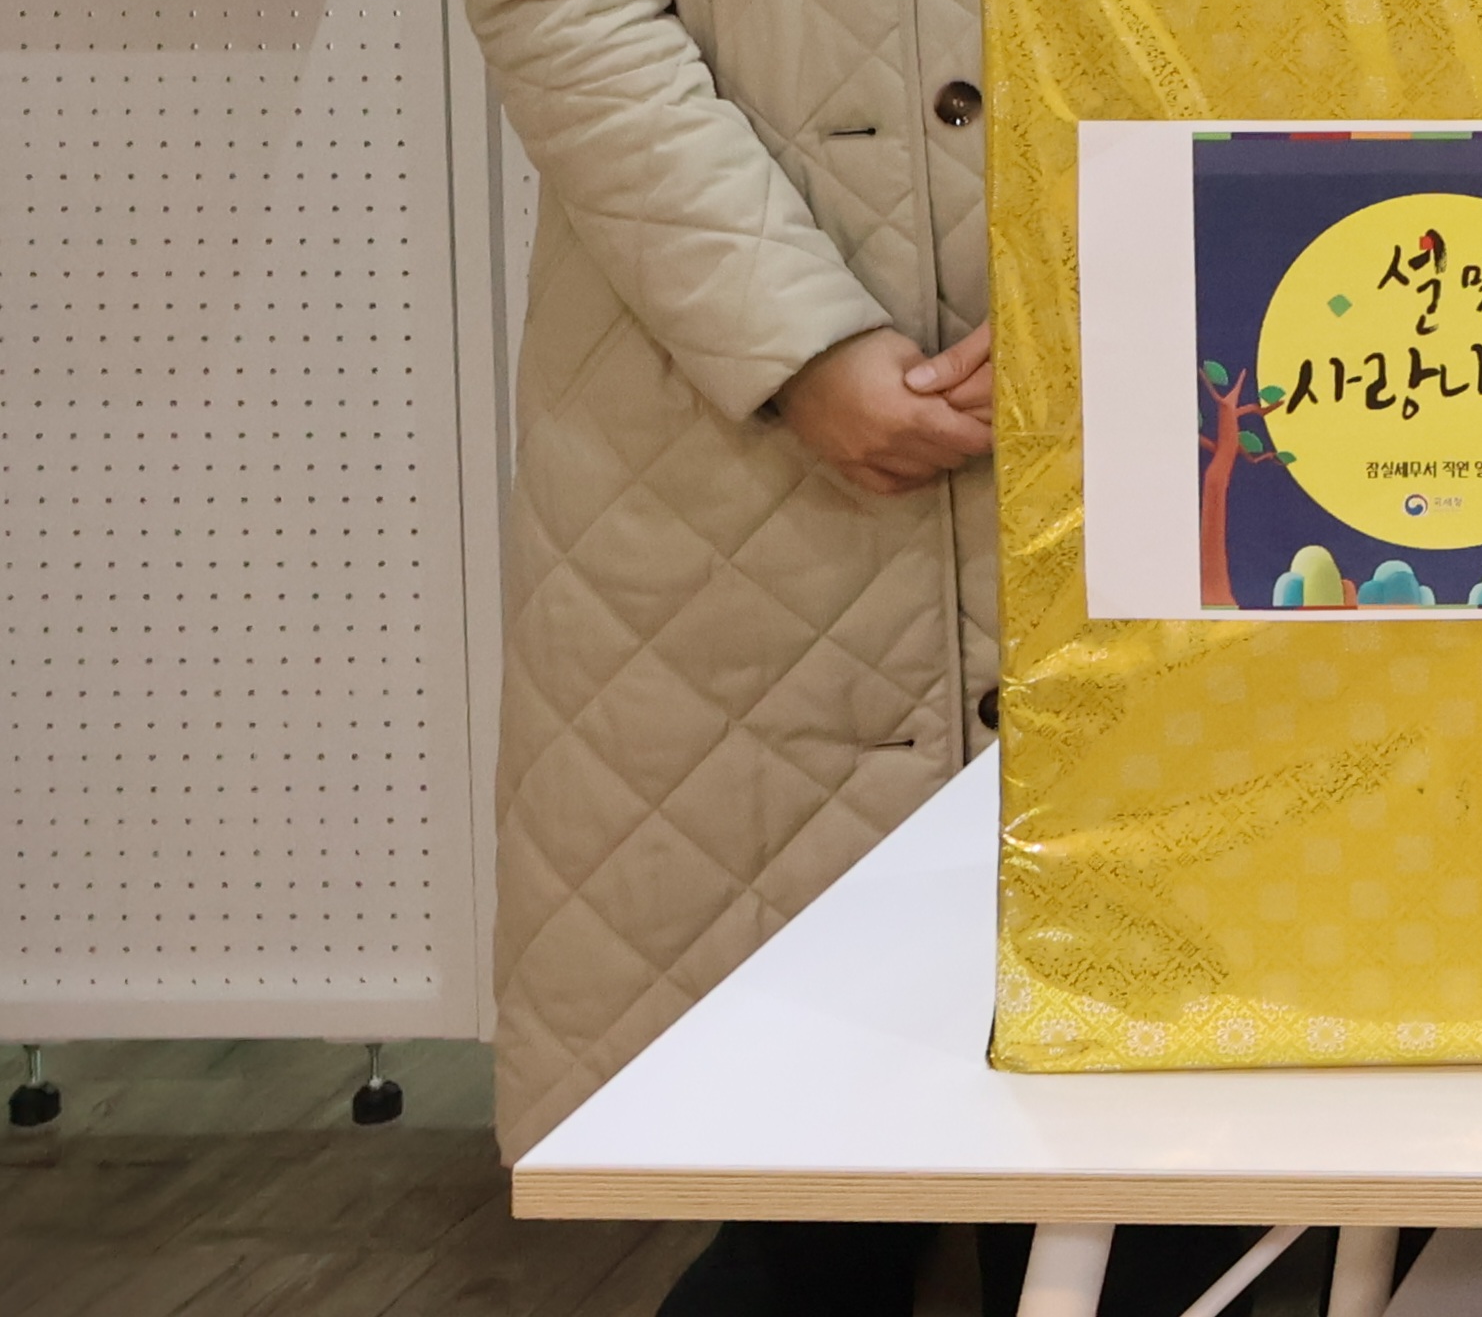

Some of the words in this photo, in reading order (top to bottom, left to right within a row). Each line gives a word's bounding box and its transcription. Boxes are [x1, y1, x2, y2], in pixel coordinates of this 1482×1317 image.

[1377, 229, 1446, 335] 설
[1366, 461, 1436, 478] 잠실세무서
[1443, 461, 1469, 478] 직원
